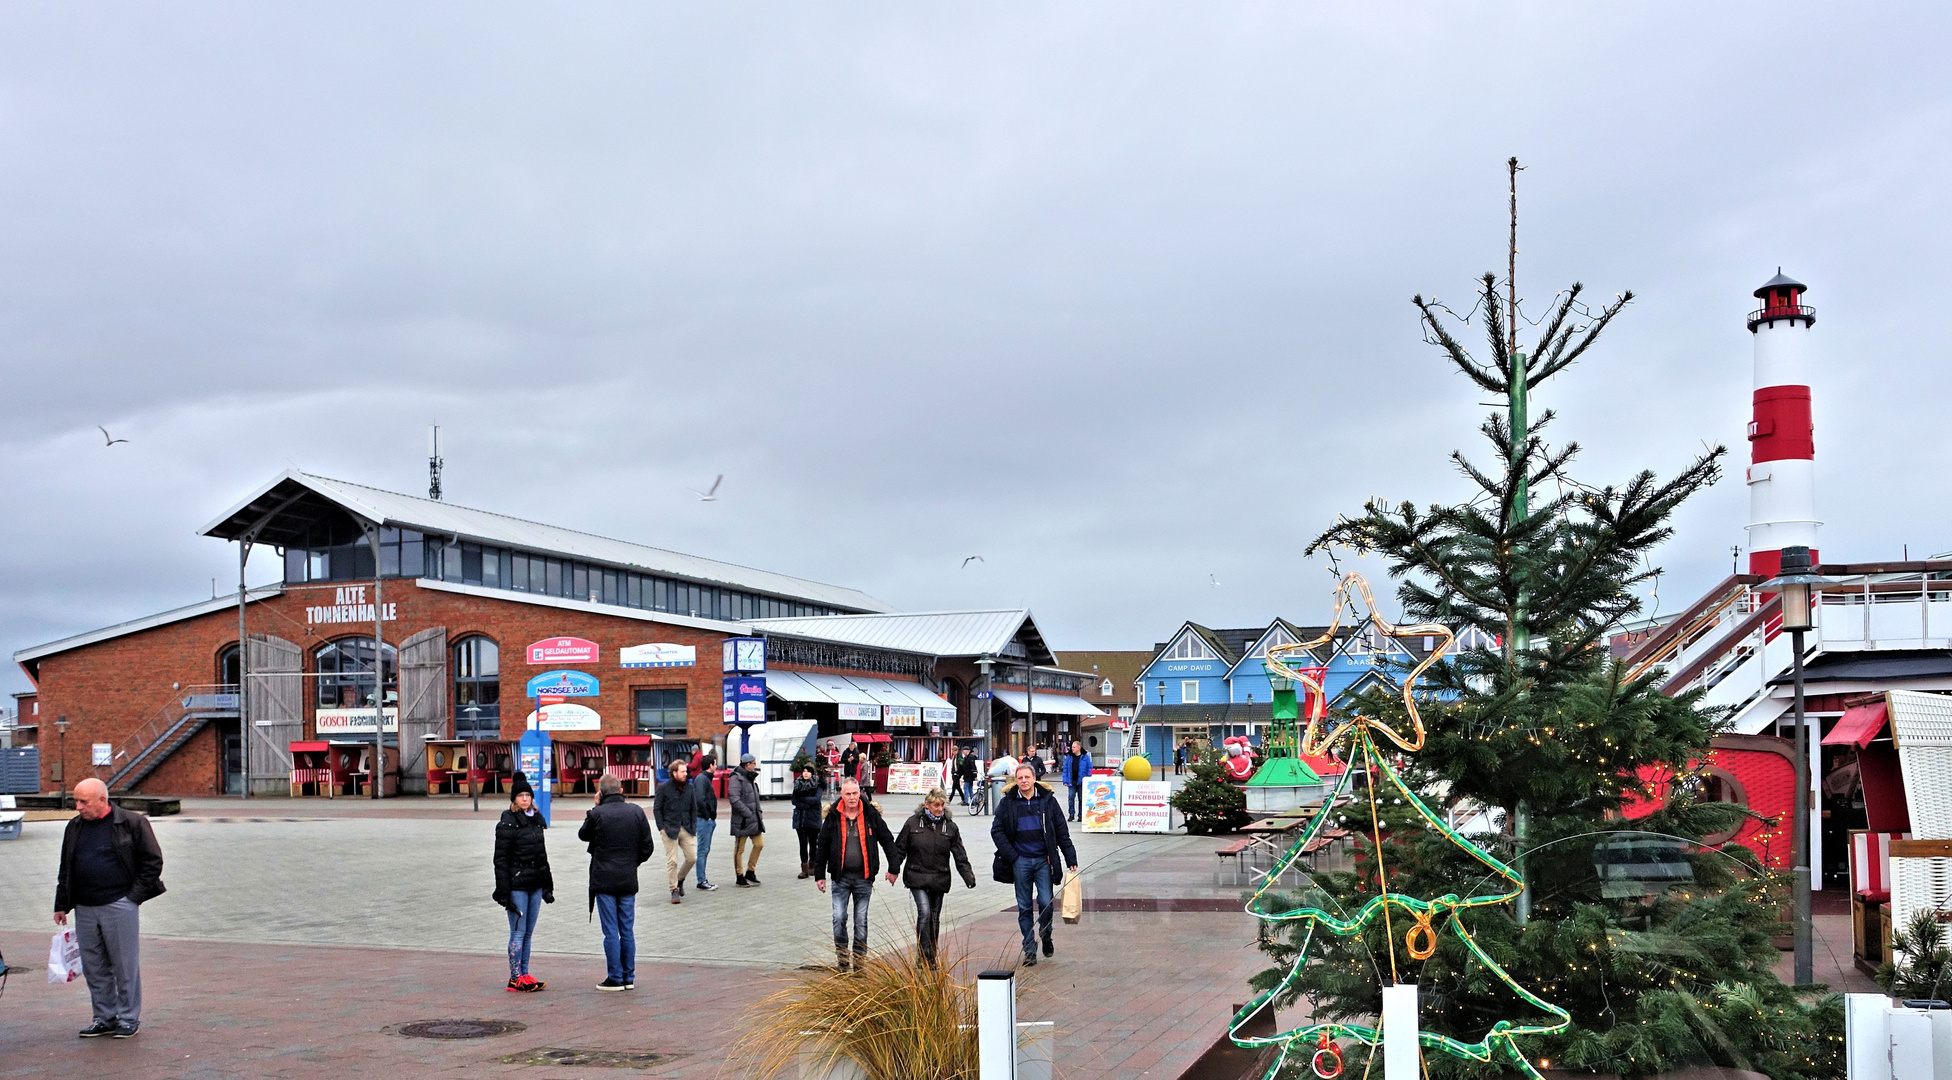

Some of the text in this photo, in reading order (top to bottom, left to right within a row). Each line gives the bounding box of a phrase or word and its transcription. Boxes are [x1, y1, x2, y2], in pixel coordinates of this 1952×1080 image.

[335, 586, 366, 605] ALTE
[306, 602, 397, 624] TONNENHALE
[544, 647, 591, 655] GELDAUTOMAT
[537, 686, 571, 694] NORDSEE
[319, 715, 348, 727] GOSCH
